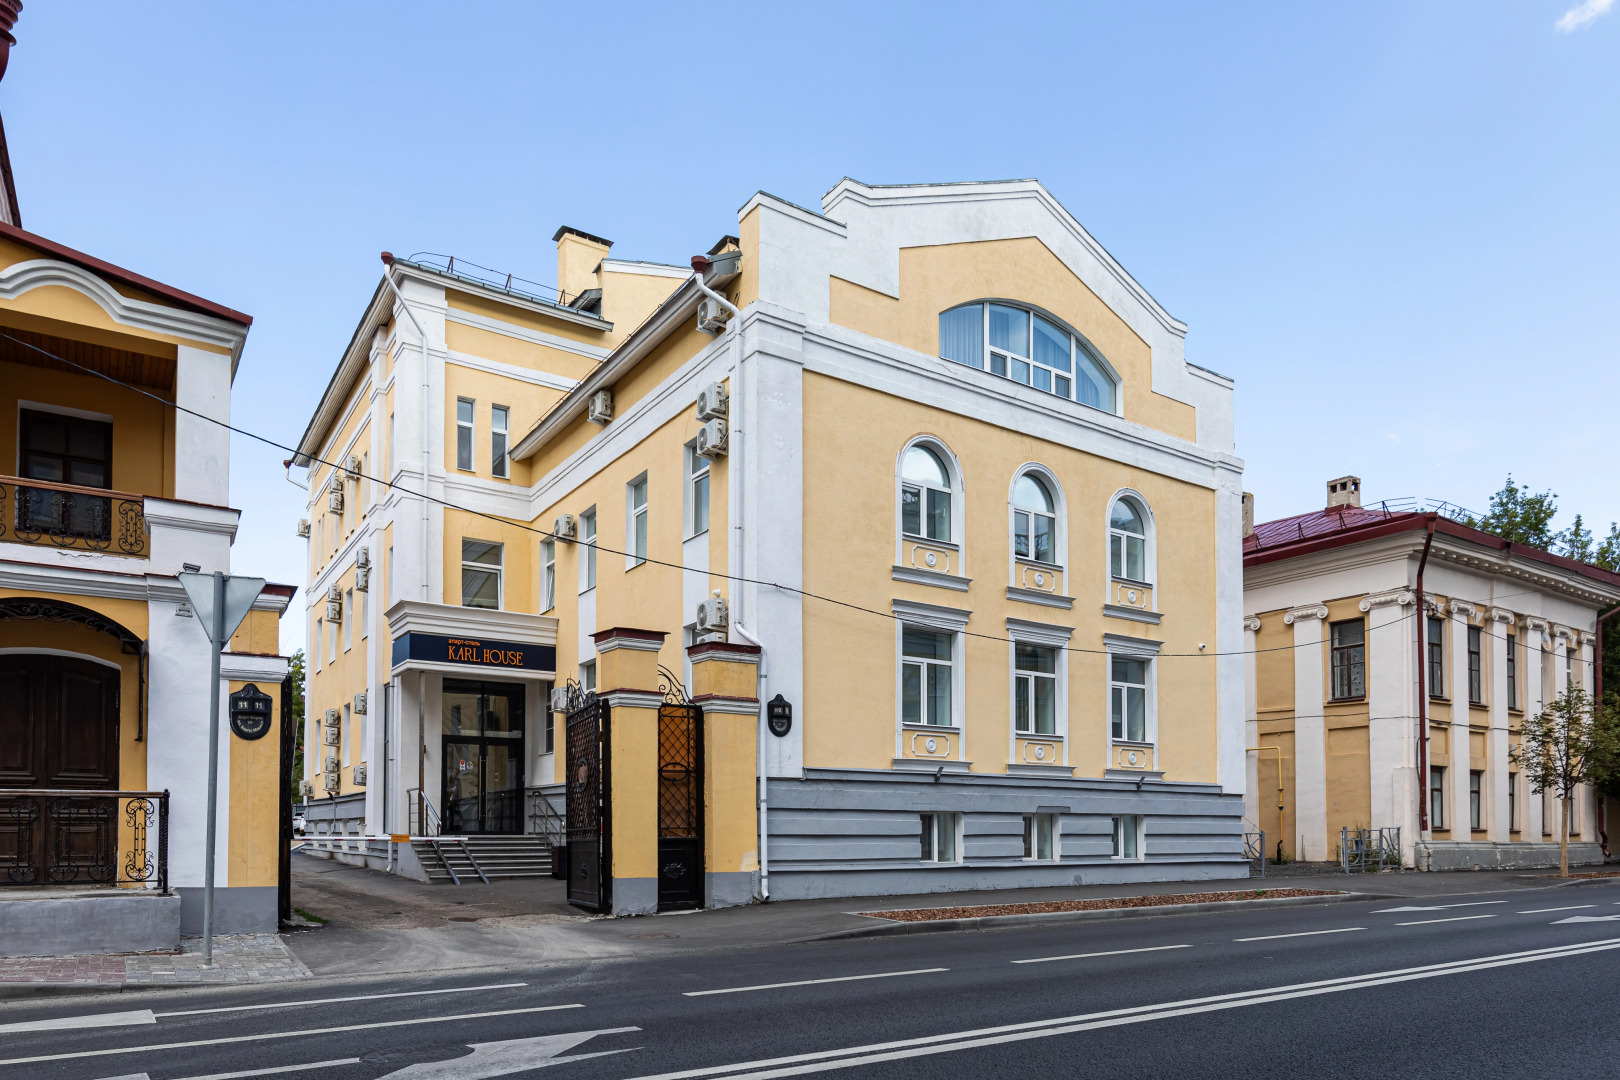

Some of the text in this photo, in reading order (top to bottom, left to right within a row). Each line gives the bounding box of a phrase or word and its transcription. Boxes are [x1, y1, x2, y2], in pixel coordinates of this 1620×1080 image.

[448, 638, 481, 647] апарт-отель
[448, 646, 523, 666] KARL HOUSE
